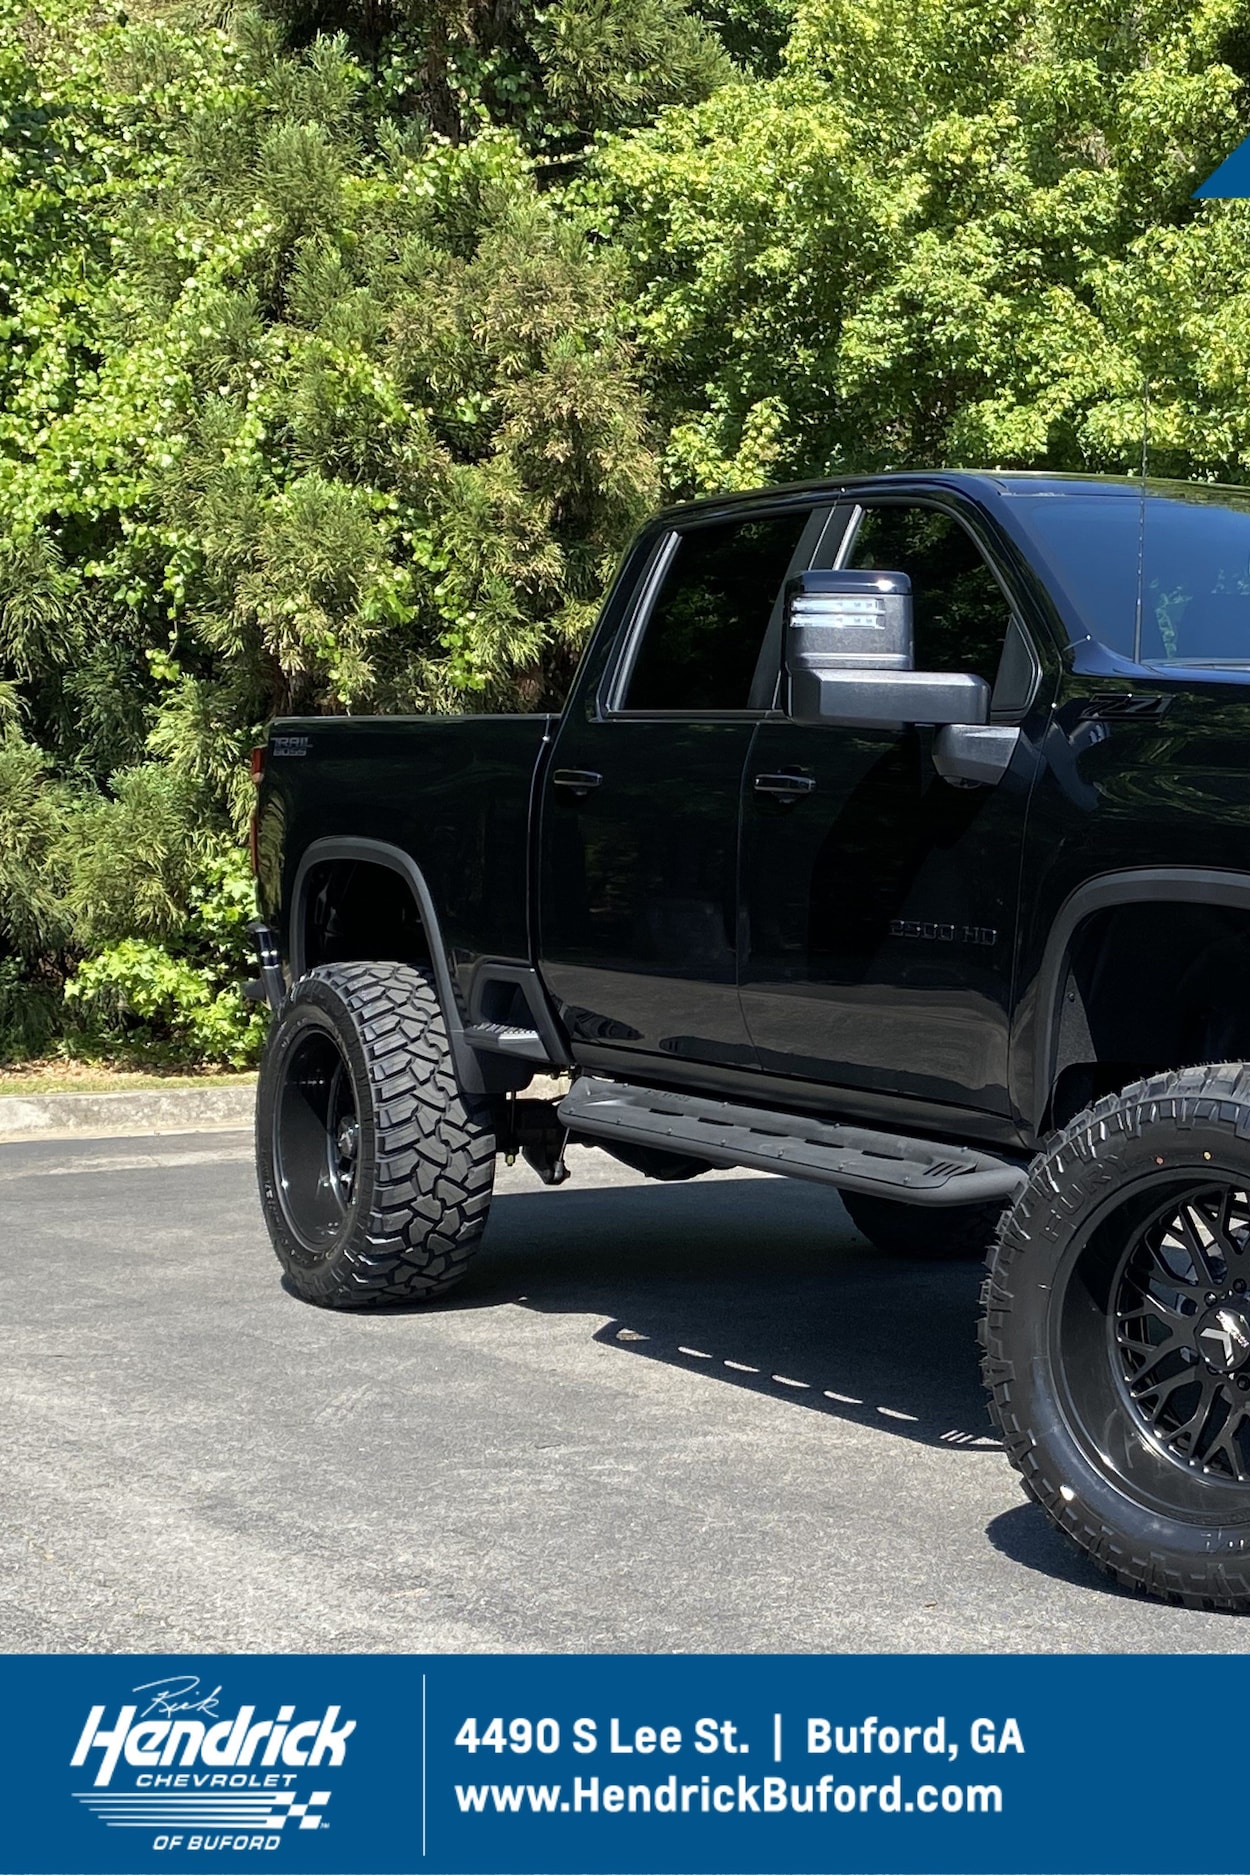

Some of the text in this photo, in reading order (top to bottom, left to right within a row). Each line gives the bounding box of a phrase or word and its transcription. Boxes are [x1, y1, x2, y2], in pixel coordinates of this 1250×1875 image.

[270, 737, 313, 748] TRAIL
[273, 747, 307, 757] BOSS
[961, 925, 998, 946] HD
